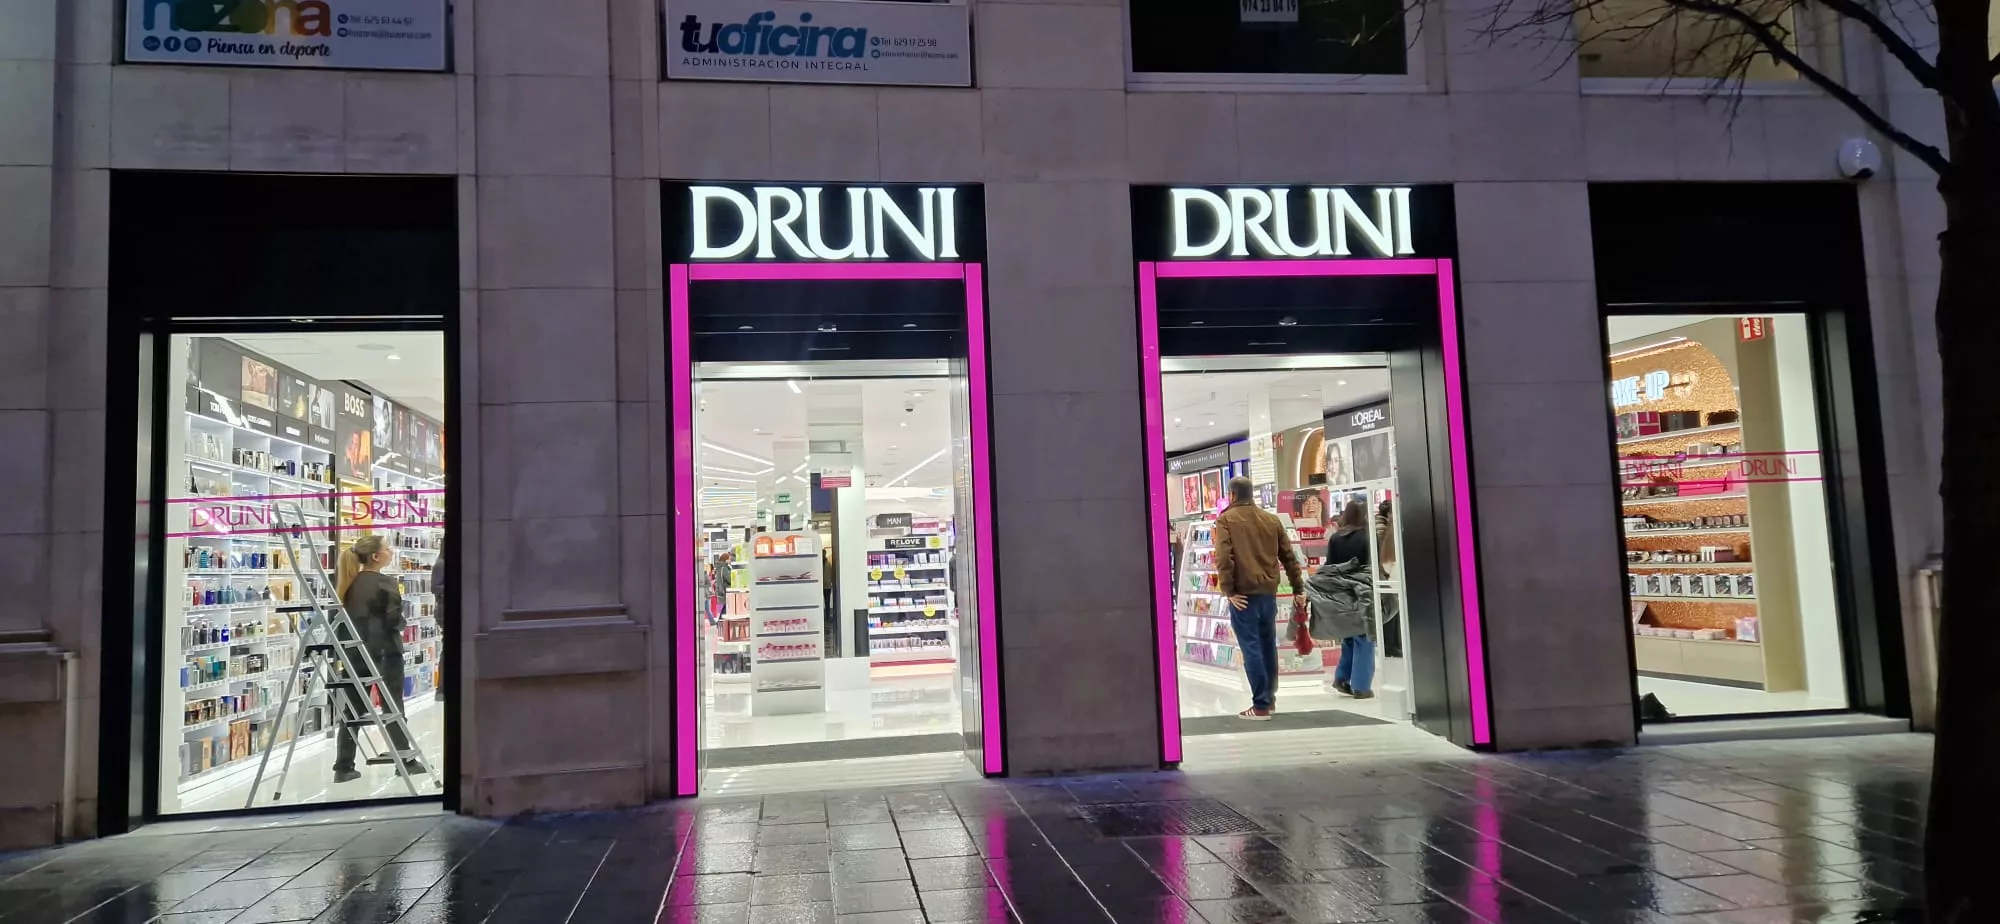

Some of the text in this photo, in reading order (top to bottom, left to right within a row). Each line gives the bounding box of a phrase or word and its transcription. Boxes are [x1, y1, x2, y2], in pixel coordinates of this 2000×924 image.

[207, 38, 331, 60] Piensa en deporte
[894, 37, 908, 46] 629
[805, 60, 869, 71] INTEGRAL
[687, 185, 961, 261] DRUNI
[1169, 187, 1416, 257] DRUNI
[344, 392, 365, 418] BOSS
[1625, 461, 1684, 480] DRUNI
[1740, 458, 1797, 476] DRUNI
[191, 504, 274, 528] DRUNI
[351, 498, 429, 521] DRUNI
[886, 517, 902, 525] MAN
[890, 538, 921, 546] RELOVE
